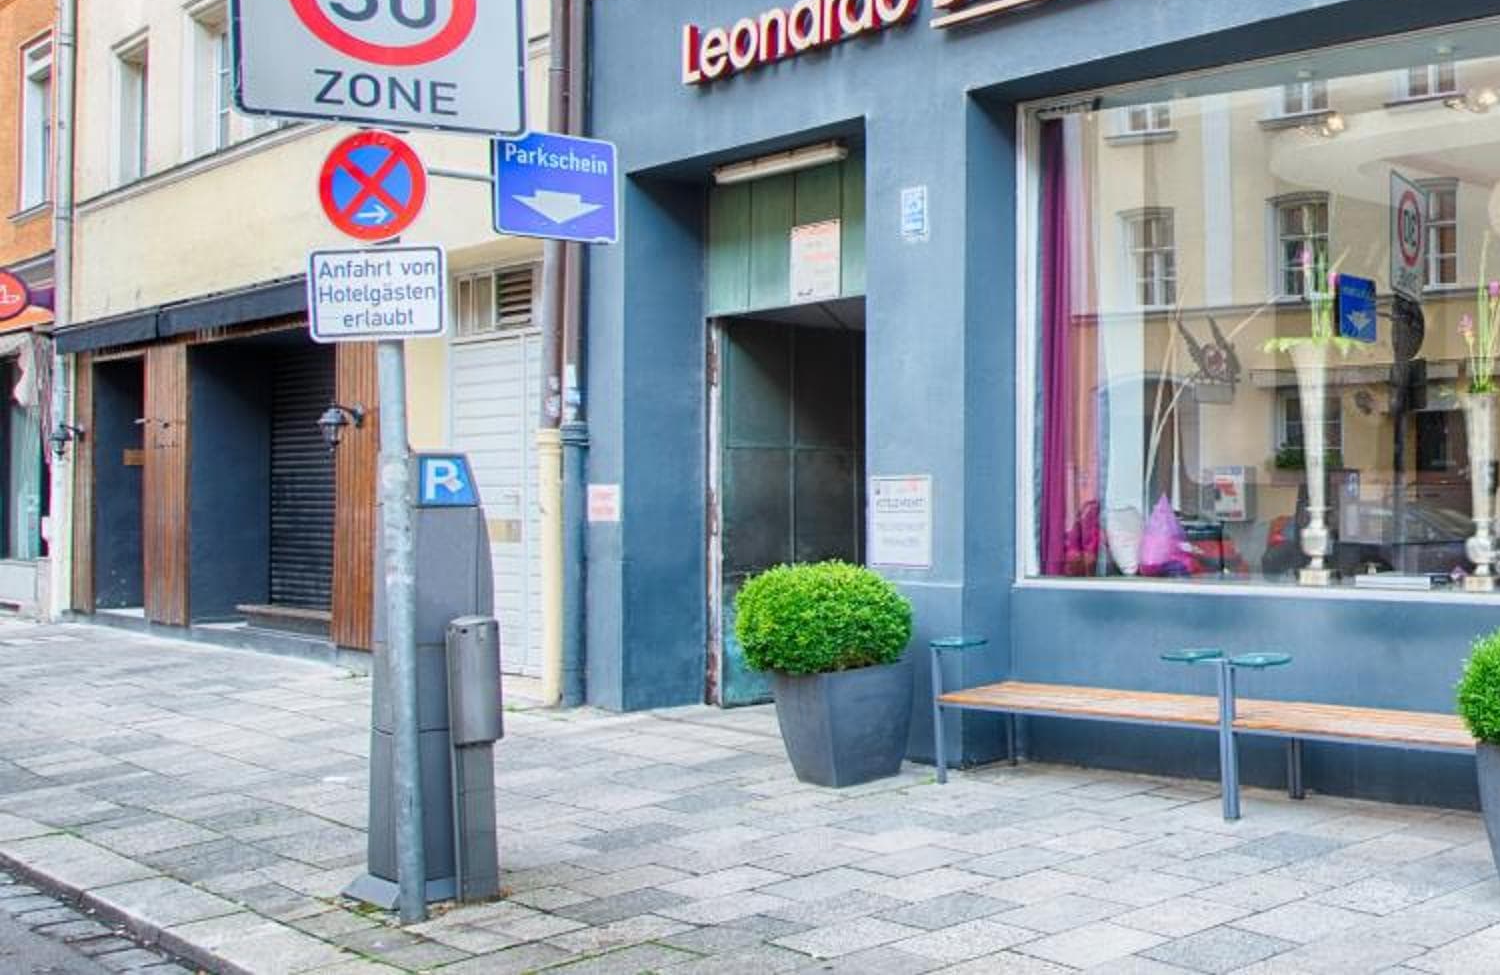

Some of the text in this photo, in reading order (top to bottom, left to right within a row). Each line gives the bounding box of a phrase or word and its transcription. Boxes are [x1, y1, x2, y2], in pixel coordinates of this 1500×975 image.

[314, 68, 458, 116] ZONE
[504, 142, 608, 176] Parkschein
[319, 259, 436, 279] Anfahrt von
[319, 283, 437, 306] Hotelgästen
[343, 308, 414, 328] erlaubt
